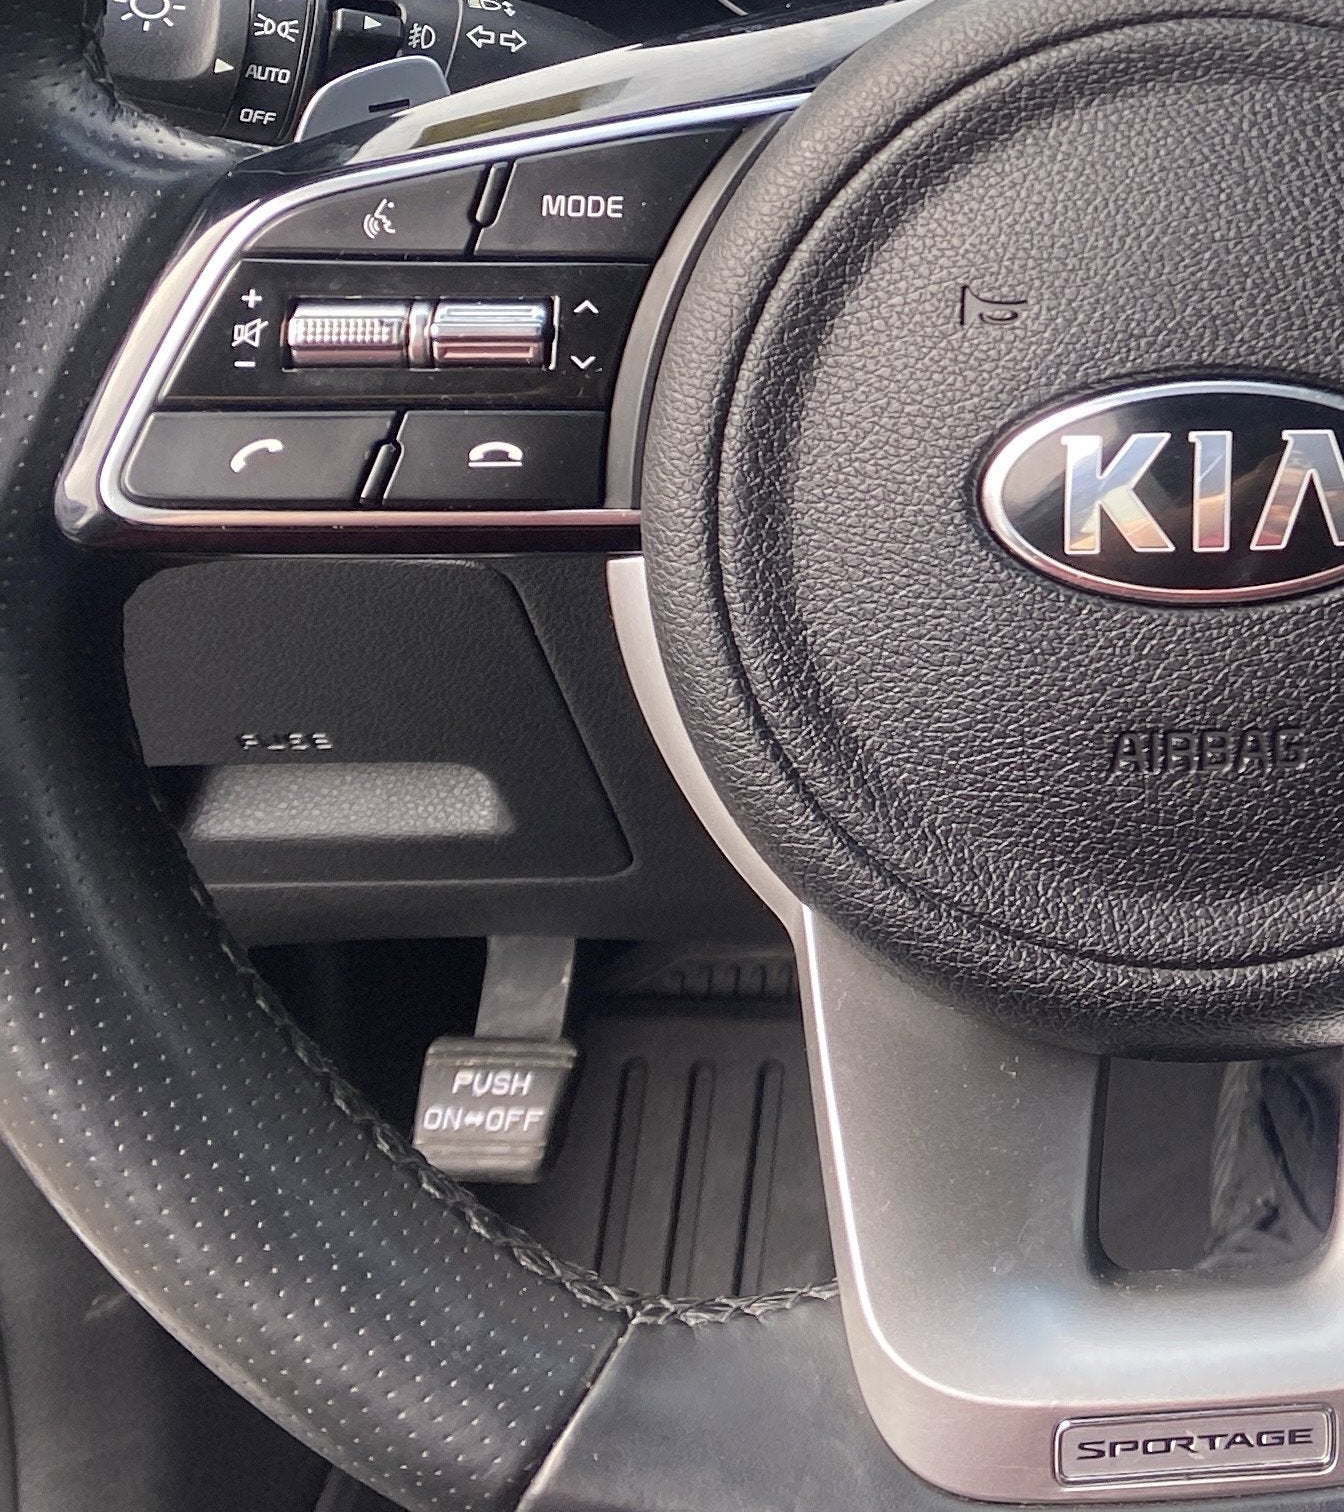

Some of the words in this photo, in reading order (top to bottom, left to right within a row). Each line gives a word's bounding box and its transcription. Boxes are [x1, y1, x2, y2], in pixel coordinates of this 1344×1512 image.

[245, 64, 291, 85] AUTO
[239, 108, 277, 126] OFF
[541, 194, 624, 219] MODE
[1112, 730, 1304, 773] AIRBAG
[452, 1069, 533, 1097] PUSH
[1077, 1428, 1314, 1460] SPORTAGE
